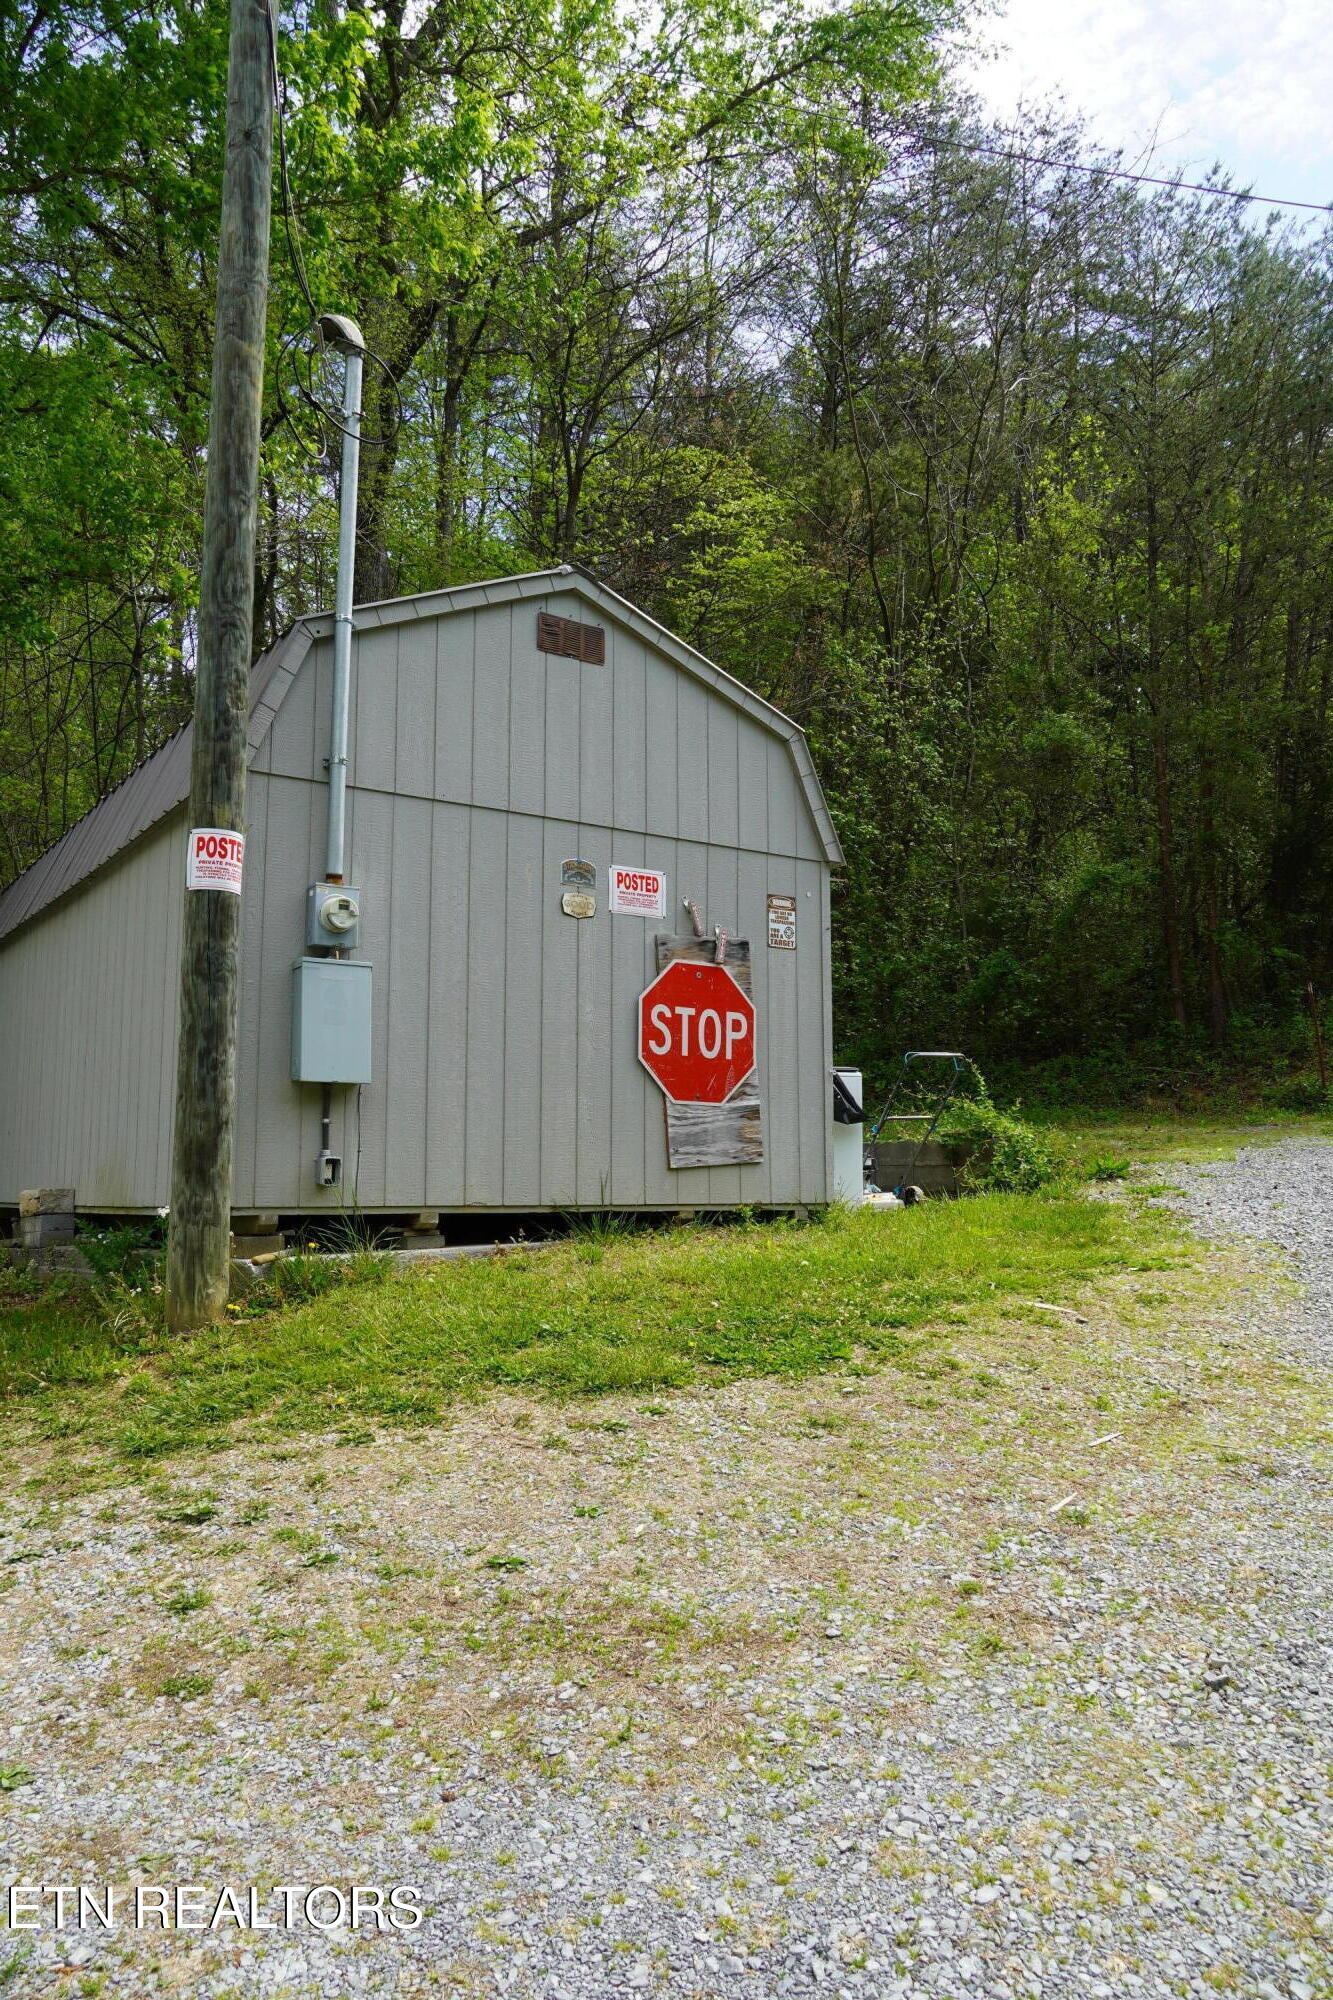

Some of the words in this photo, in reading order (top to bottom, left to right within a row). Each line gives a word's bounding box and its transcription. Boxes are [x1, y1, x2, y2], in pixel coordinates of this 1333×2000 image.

[196, 836, 243, 863] POSTE
[617, 871, 659, 893] POSTED
[770, 939, 795, 947] TARGET
[649, 1003, 748, 1060] STOP
